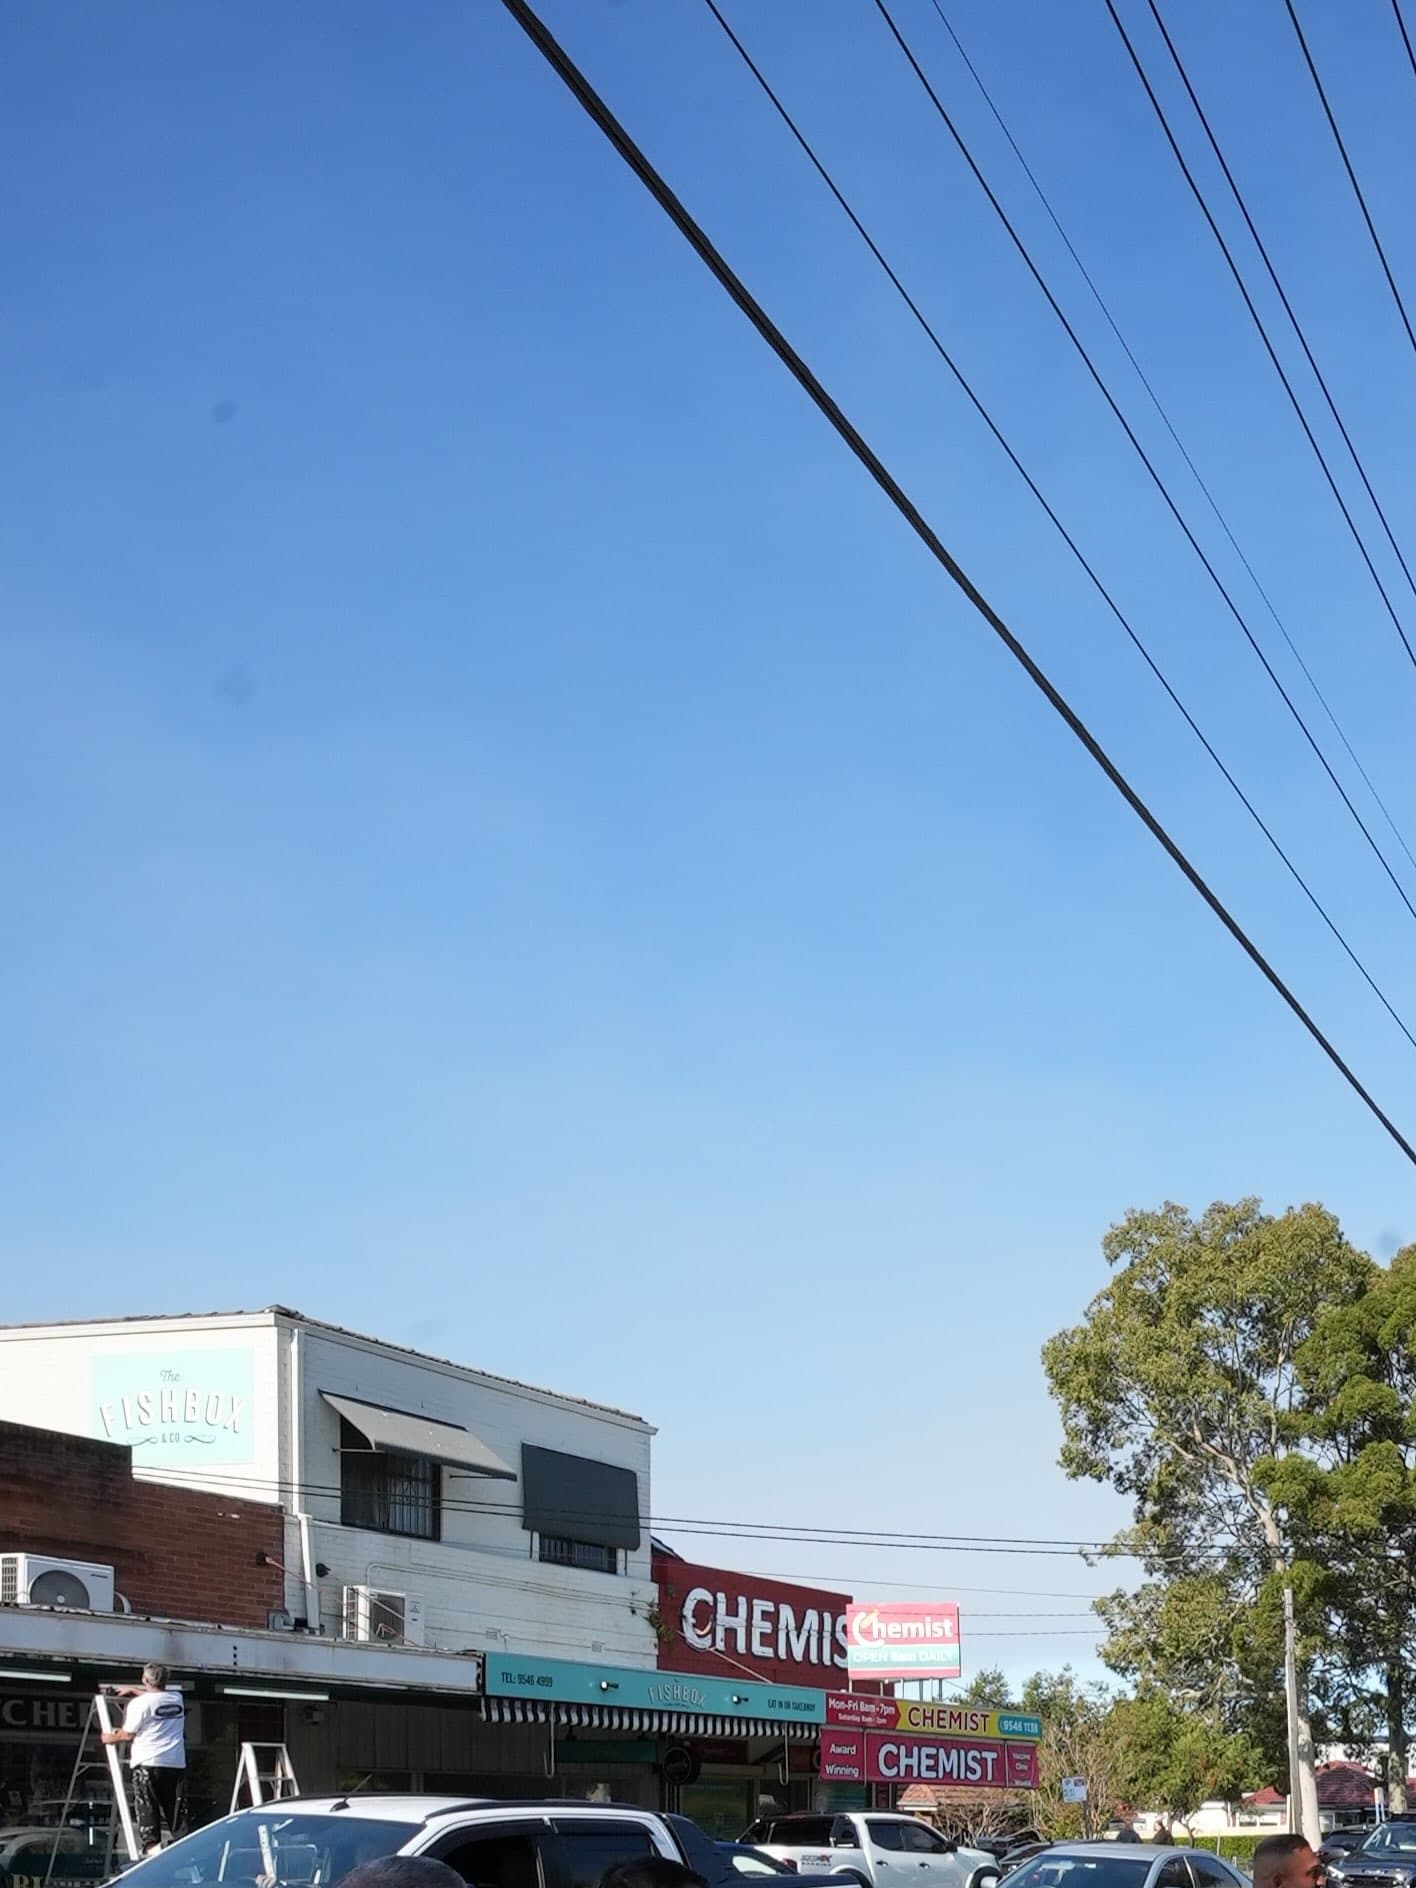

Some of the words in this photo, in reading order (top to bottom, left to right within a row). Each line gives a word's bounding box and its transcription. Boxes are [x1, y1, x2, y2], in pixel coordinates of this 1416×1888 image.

[160, 1369, 181, 1382] The
[99, 1387, 245, 1439] FISHBOX
[681, 1587, 848, 1669] CHEMIS
[852, 1610, 954, 1648] Chemist
[648, 1682, 706, 1708] FISHBOX
[908, 1706, 991, 1733] CHEMIST
[829, 1744, 857, 1756] Award
[878, 1743, 998, 1782] CHEMIST
[825, 1764, 860, 1778] Winning
